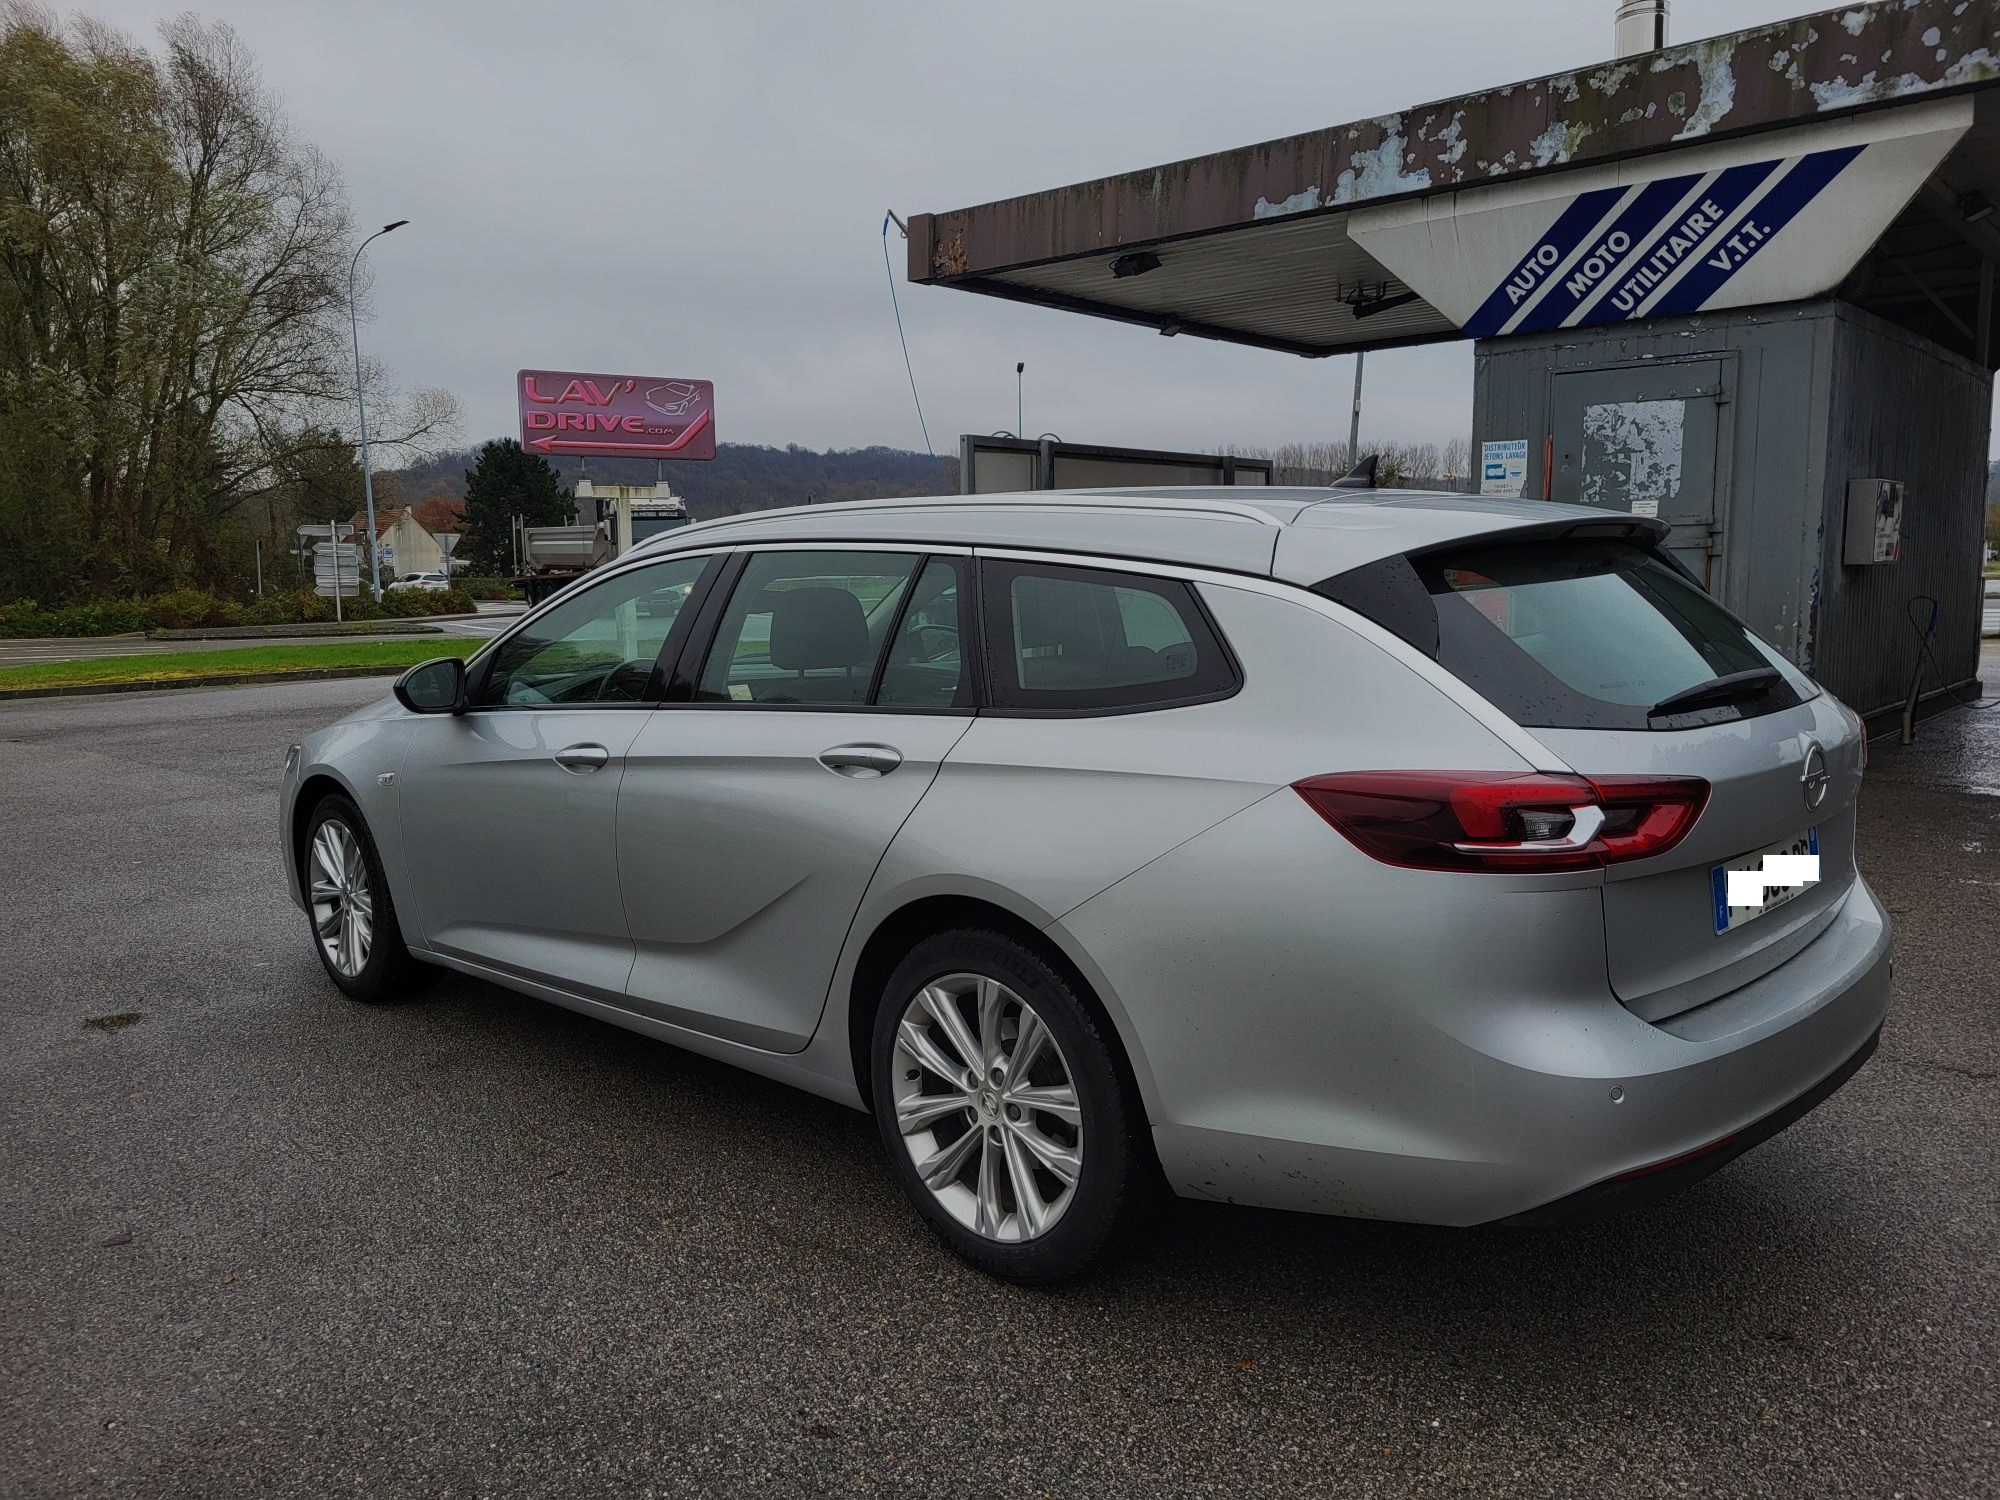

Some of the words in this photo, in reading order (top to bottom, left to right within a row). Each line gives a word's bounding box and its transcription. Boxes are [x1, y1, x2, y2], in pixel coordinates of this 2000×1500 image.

[1504, 244, 1559, 305] AUTO
[1565, 231, 1630, 299] MOTO
[1610, 199, 1725, 311] UTILITAIRE
[1707, 220, 1771, 271] V.T.T.
[525, 376, 636, 406] LAV'
